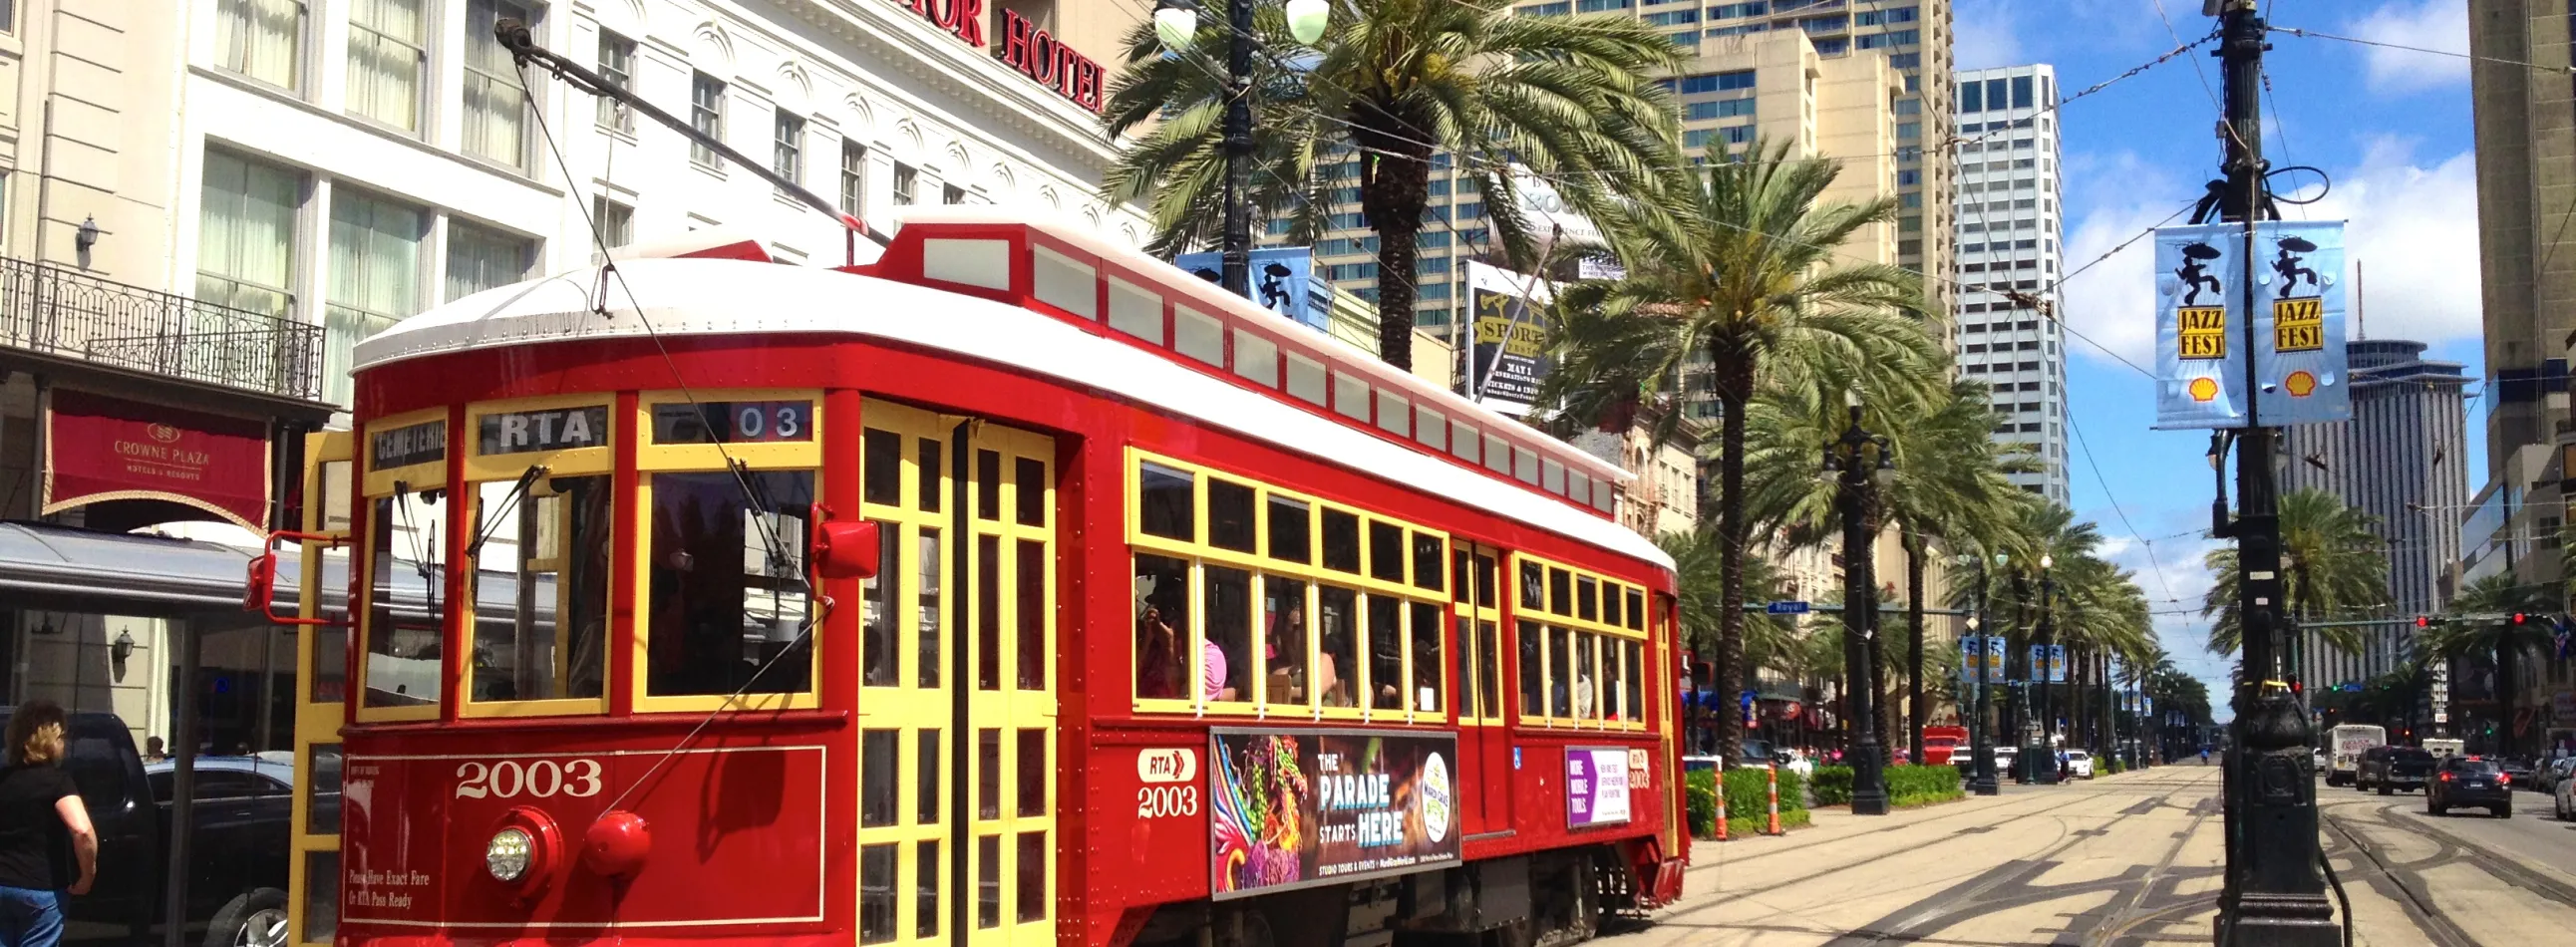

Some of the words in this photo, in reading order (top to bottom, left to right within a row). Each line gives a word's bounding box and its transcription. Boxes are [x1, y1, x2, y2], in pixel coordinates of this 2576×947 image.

[1005, 8, 1107, 113] HOTEL
[1538, 226, 1585, 236] EXPIENCE
[2180, 310, 2223, 333] JAZZ
[2276, 301, 2320, 326] JAZZ
[1484, 321, 1544, 344] SHORT
[2277, 326, 2322, 348] FEST
[2180, 335, 2224, 355] FEST
[1506, 363, 1526, 375] MAY
[1526, 367, 1532, 376] 1
[1487, 380, 1515, 391] TICKETS
[500, 410, 592, 448] RTA
[115, 440, 167, 460] CROWNE
[172, 449, 209, 466] PLAZA
[127, 465, 156, 475] HOTELS
[166, 470, 200, 480] RESORTS
[1149, 756, 1170, 775] RTA
[1317, 754, 1339, 772] THE
[456, 759, 602, 799] 2003
[1629, 771, 1650, 789] 2003
[1137, 786, 1197, 819] 2003
[1320, 774, 1390, 811] PARADE
[1319, 823, 1356, 844] STARTS
[1358, 810, 1404, 847] HERE
[367, 869, 384, 885] Have
[386, 869, 409, 885] Exact
[411, 869, 430, 886] Fare
[1319, 864, 1337, 876] STUDIO
[1338, 862, 1354, 874] TOURS
[1358, 859, 1376, 870] EVENTS
[348, 890, 356, 905] Or
[371, 891, 387, 907] Pass
[389, 891, 413, 910] Ready
